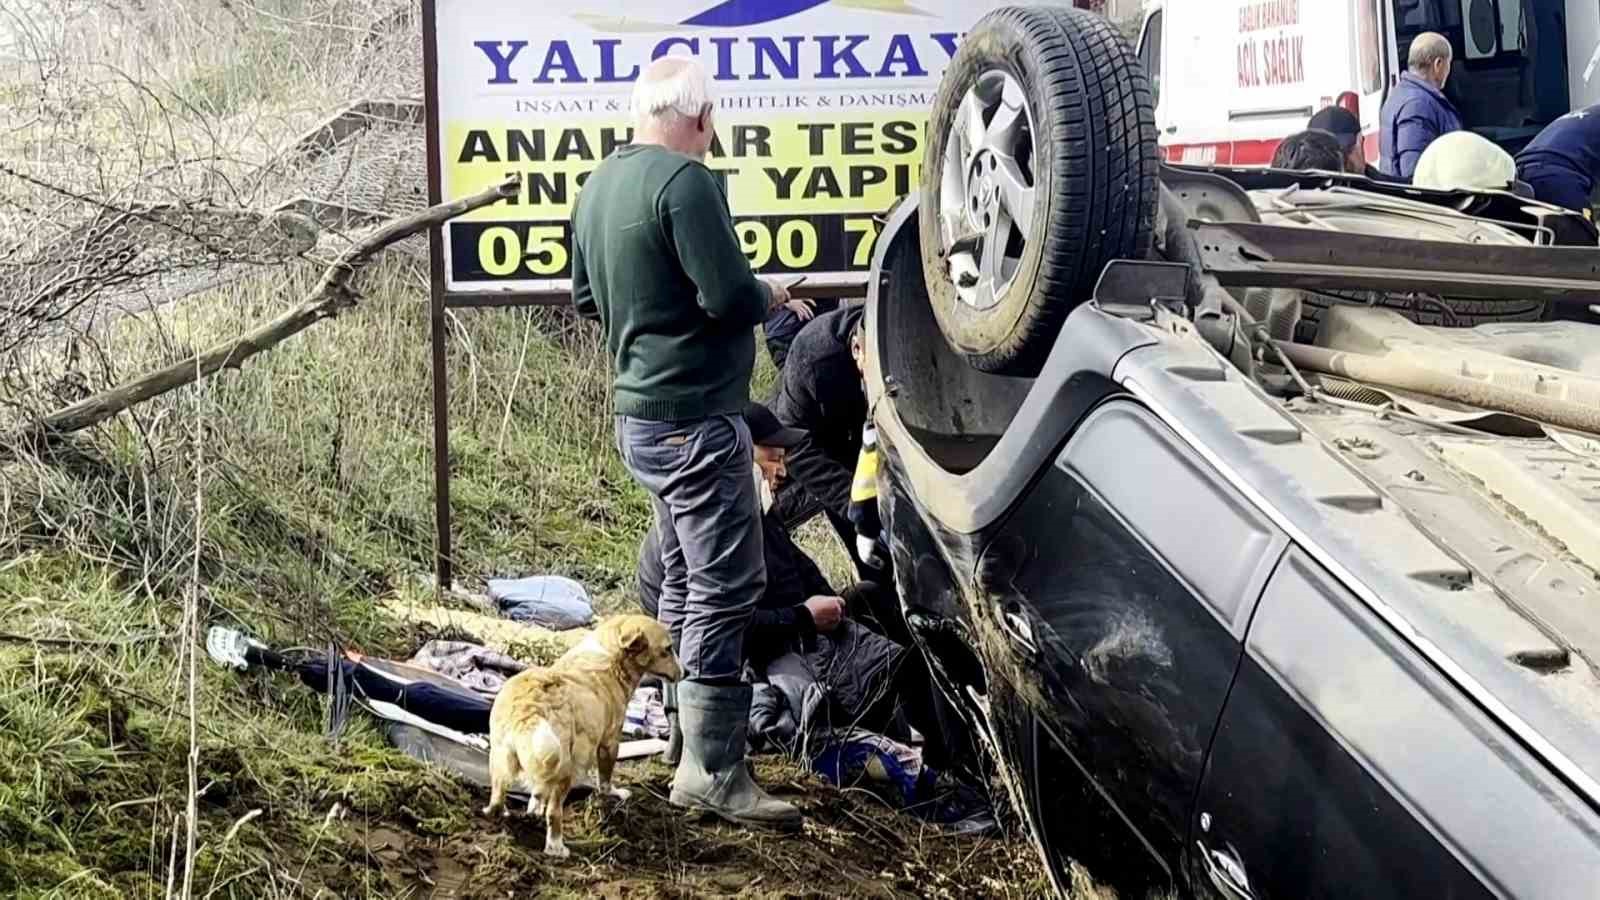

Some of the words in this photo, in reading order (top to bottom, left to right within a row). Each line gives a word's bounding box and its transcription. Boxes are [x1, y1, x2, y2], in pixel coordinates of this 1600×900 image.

[604, 98, 620, 112] &
[816, 95, 832, 108] &
[797, 121, 929, 156] TES
[762, 164, 922, 200] YAPI
[478, 226, 569, 276] 05
[734, 218, 818, 269] 90
[844, 217, 878, 266] 7
